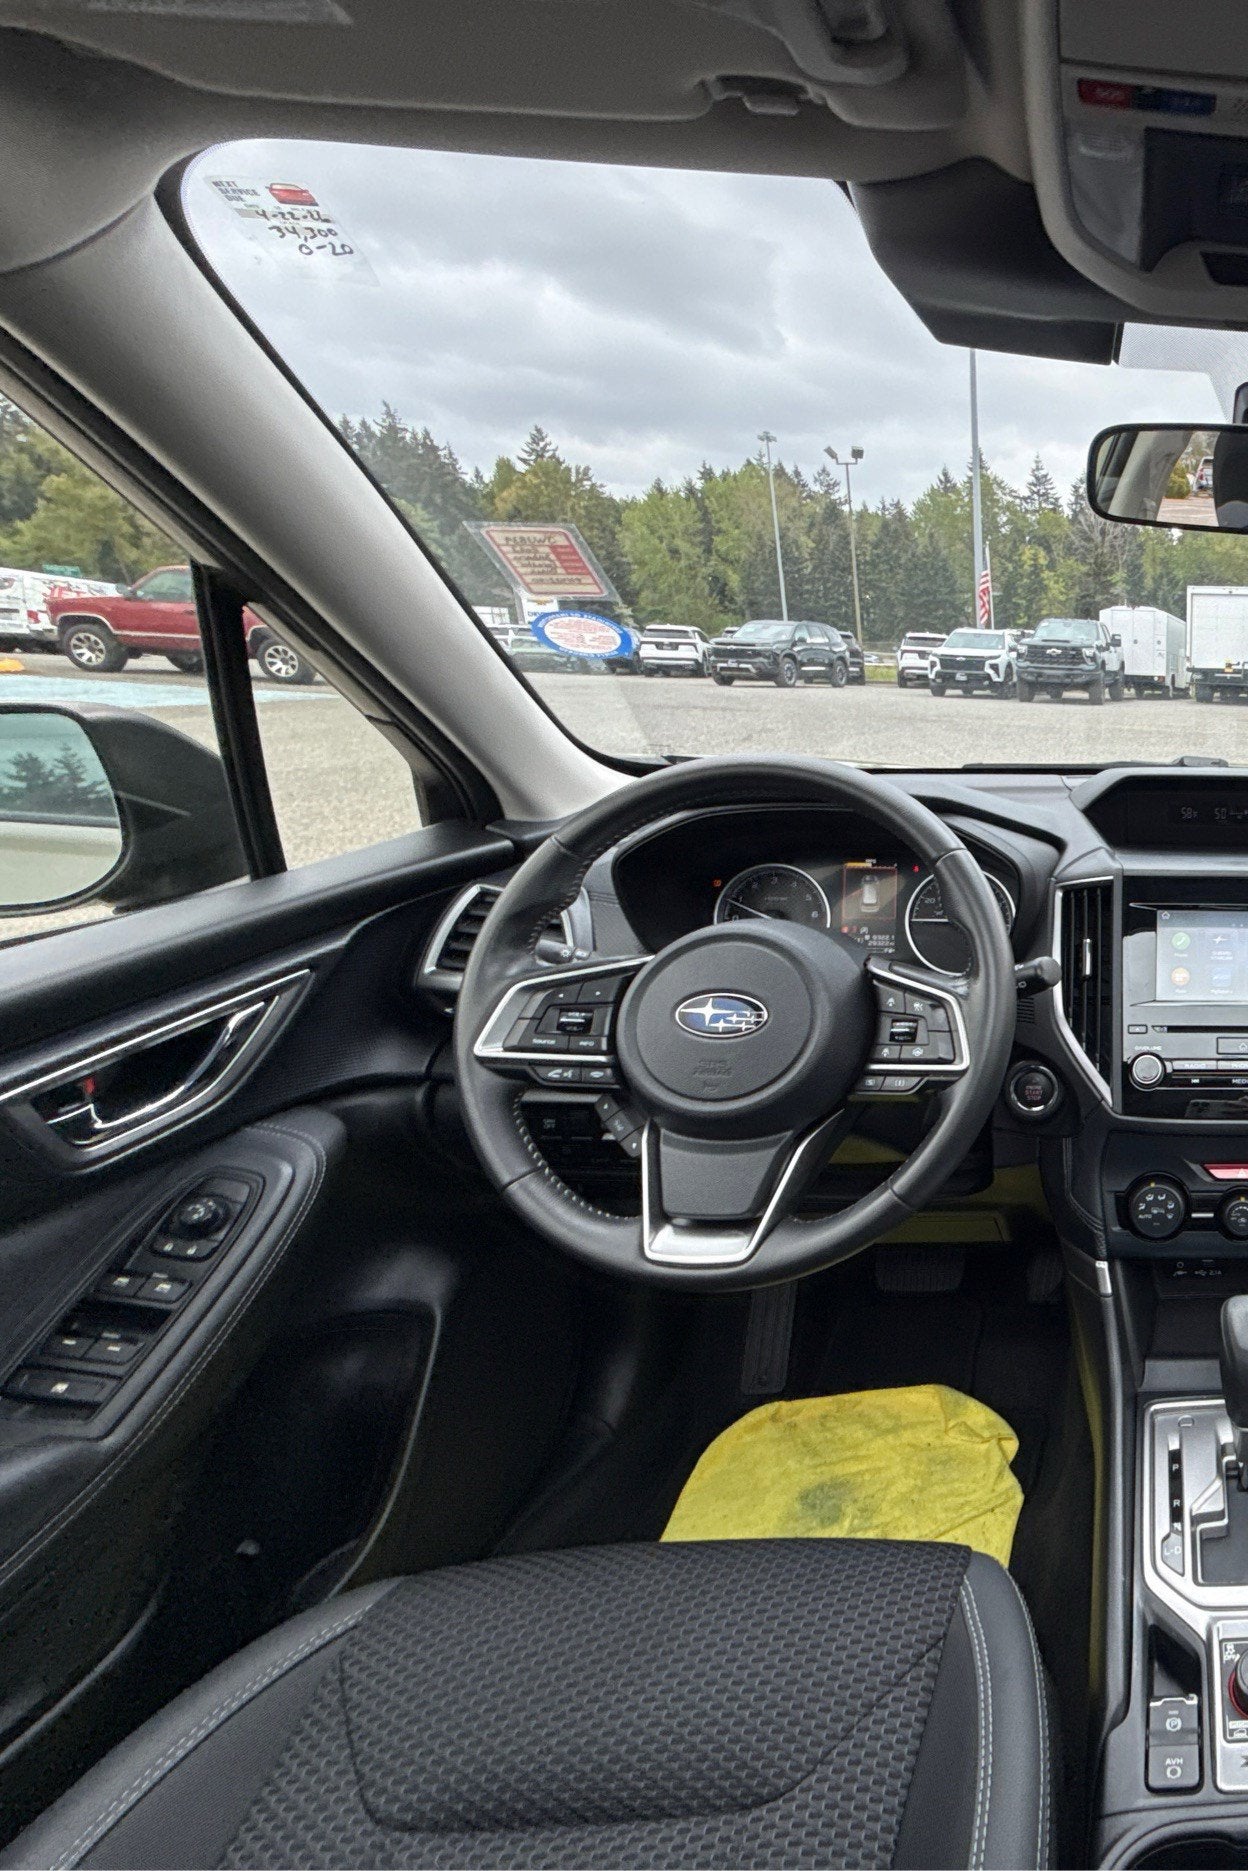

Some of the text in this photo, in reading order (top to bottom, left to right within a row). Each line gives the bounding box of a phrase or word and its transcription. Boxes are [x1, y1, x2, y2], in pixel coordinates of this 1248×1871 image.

[219, 188, 260, 196] SERVICE
[1172, 1463, 1180, 1472] P
[1173, 1499, 1181, 1508] R
[1165, 1757, 1184, 1765] AVH
